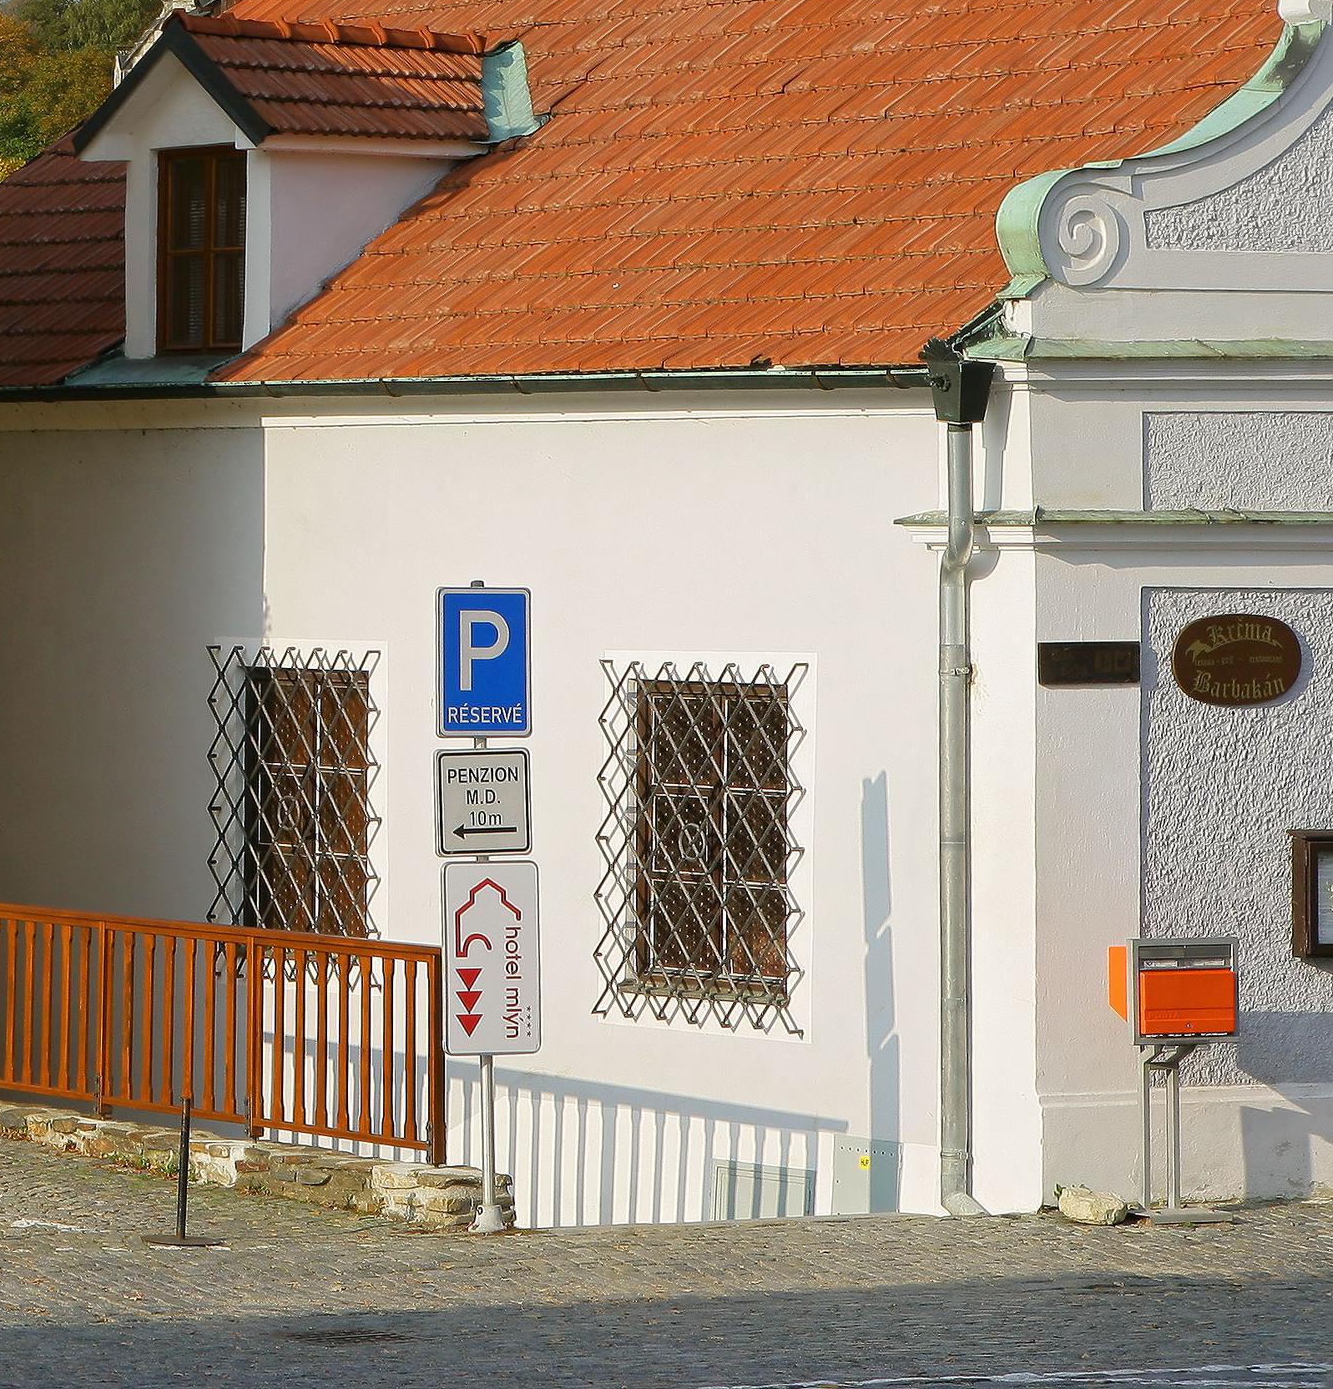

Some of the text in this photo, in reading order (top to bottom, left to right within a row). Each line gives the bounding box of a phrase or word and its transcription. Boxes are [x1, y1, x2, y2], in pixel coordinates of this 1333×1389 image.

[459, 609, 511, 692] P
[1193, 671, 1286, 700] Barbakán
[448, 703, 523, 724] RÉSERVÉ
[446, 766, 519, 784] PENZION
[466, 789, 501, 805] M.D.
[502, 926, 523, 1039] hotel mlýn
